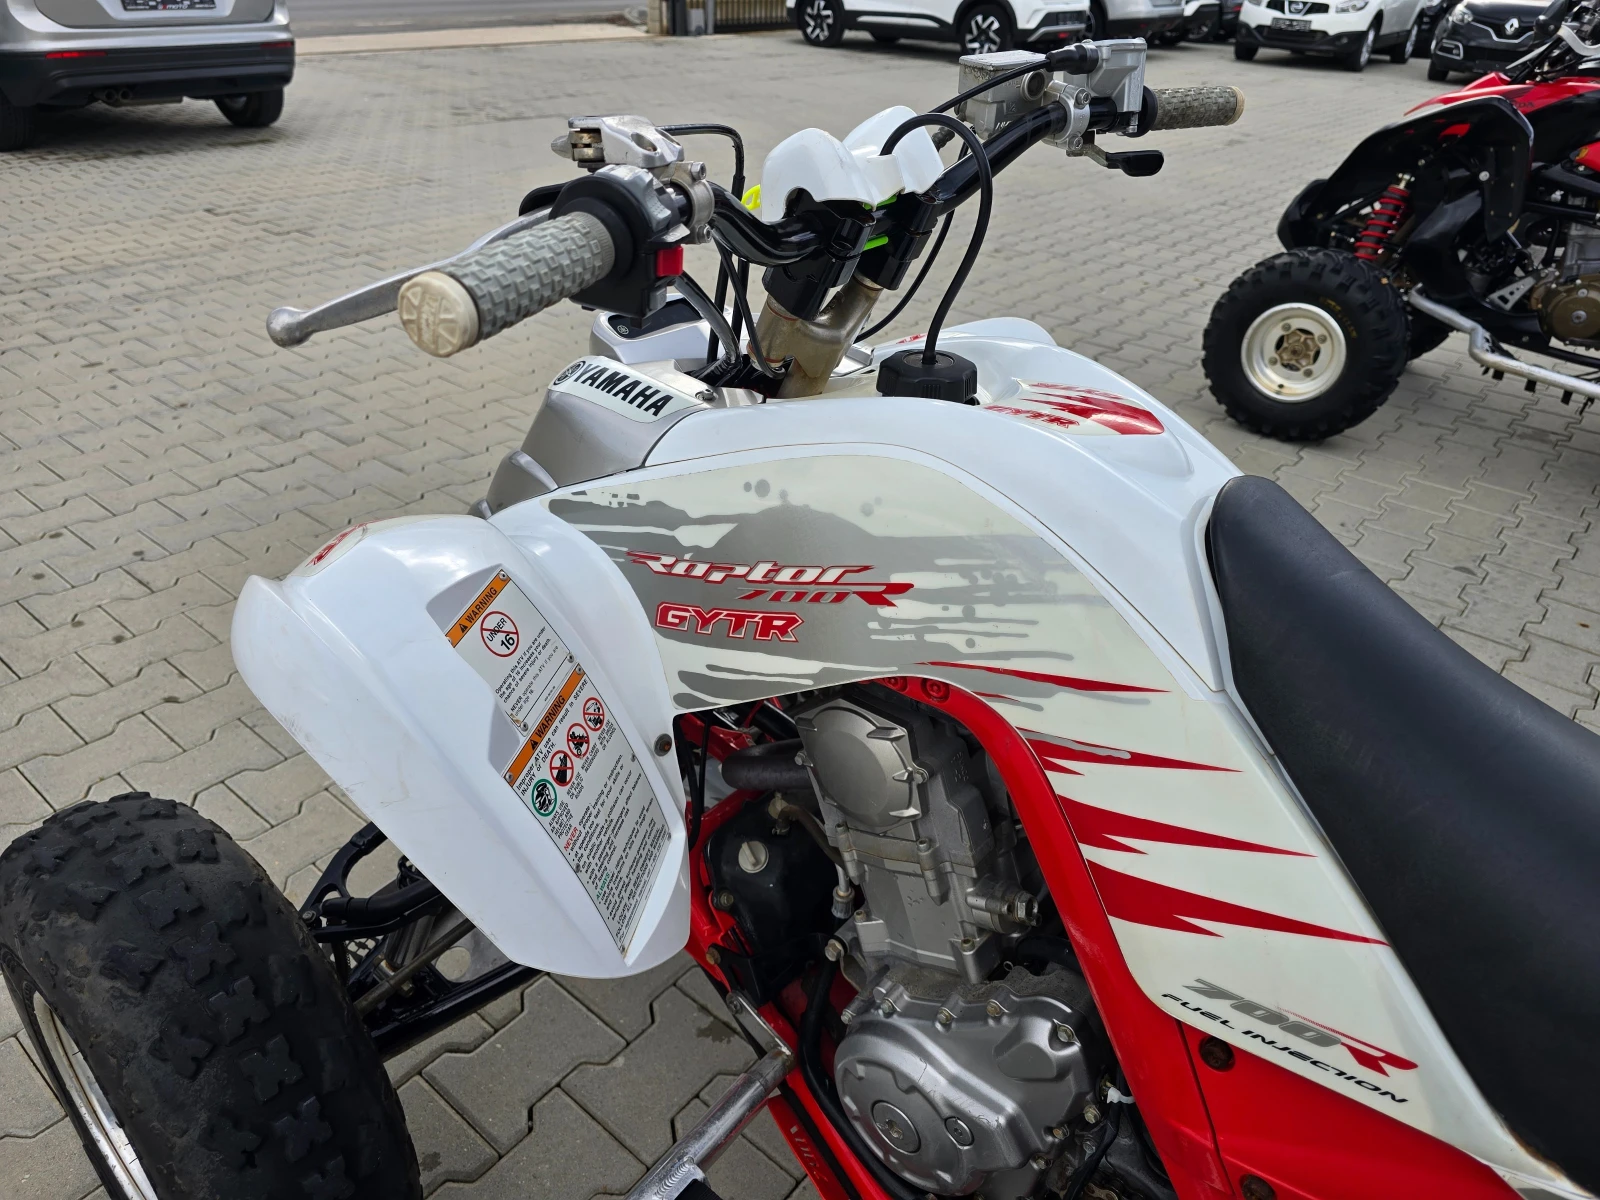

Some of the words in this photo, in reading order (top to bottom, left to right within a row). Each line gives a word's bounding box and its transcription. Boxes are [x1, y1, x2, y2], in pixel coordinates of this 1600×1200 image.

[573, 363, 675, 417] YAMAHA
[626, 550, 875, 585] Raptor
[466, 587, 498, 624] WARNING
[736, 581, 915, 608] 700R
[486, 617, 507, 641] UNDER
[500, 631, 515, 650] 16
[655, 601, 805, 643] GYTR
[495, 672, 512, 694] Operating
[510, 664, 518, 673] this
[536, 626, 545, 638] under
[503, 687, 515, 703] chance
[518, 667, 529, 681] severe
[527, 655, 538, 667] injury
[541, 638, 550, 650] death.
[519, 651, 534, 670] increases
[533, 641, 541, 652] your
[515, 763, 534, 790] Improper
[534, 748, 543, 762] ATV
[543, 737, 551, 748] use
[558, 707, 569, 724] result
[573, 678, 587, 700] SEVERE
[534, 694, 565, 738] WARNING
[520, 771, 535, 796] INJURY
[536, 763, 541, 771] or
[541, 741, 556, 763] DEATH.
[596, 871, 609, 900] ALWAYS
[1161, 993, 1236, 1030] FUEL
[1241, 1030, 1409, 1104] INJECTION
[1182, 978, 1419, 1078] 700R
